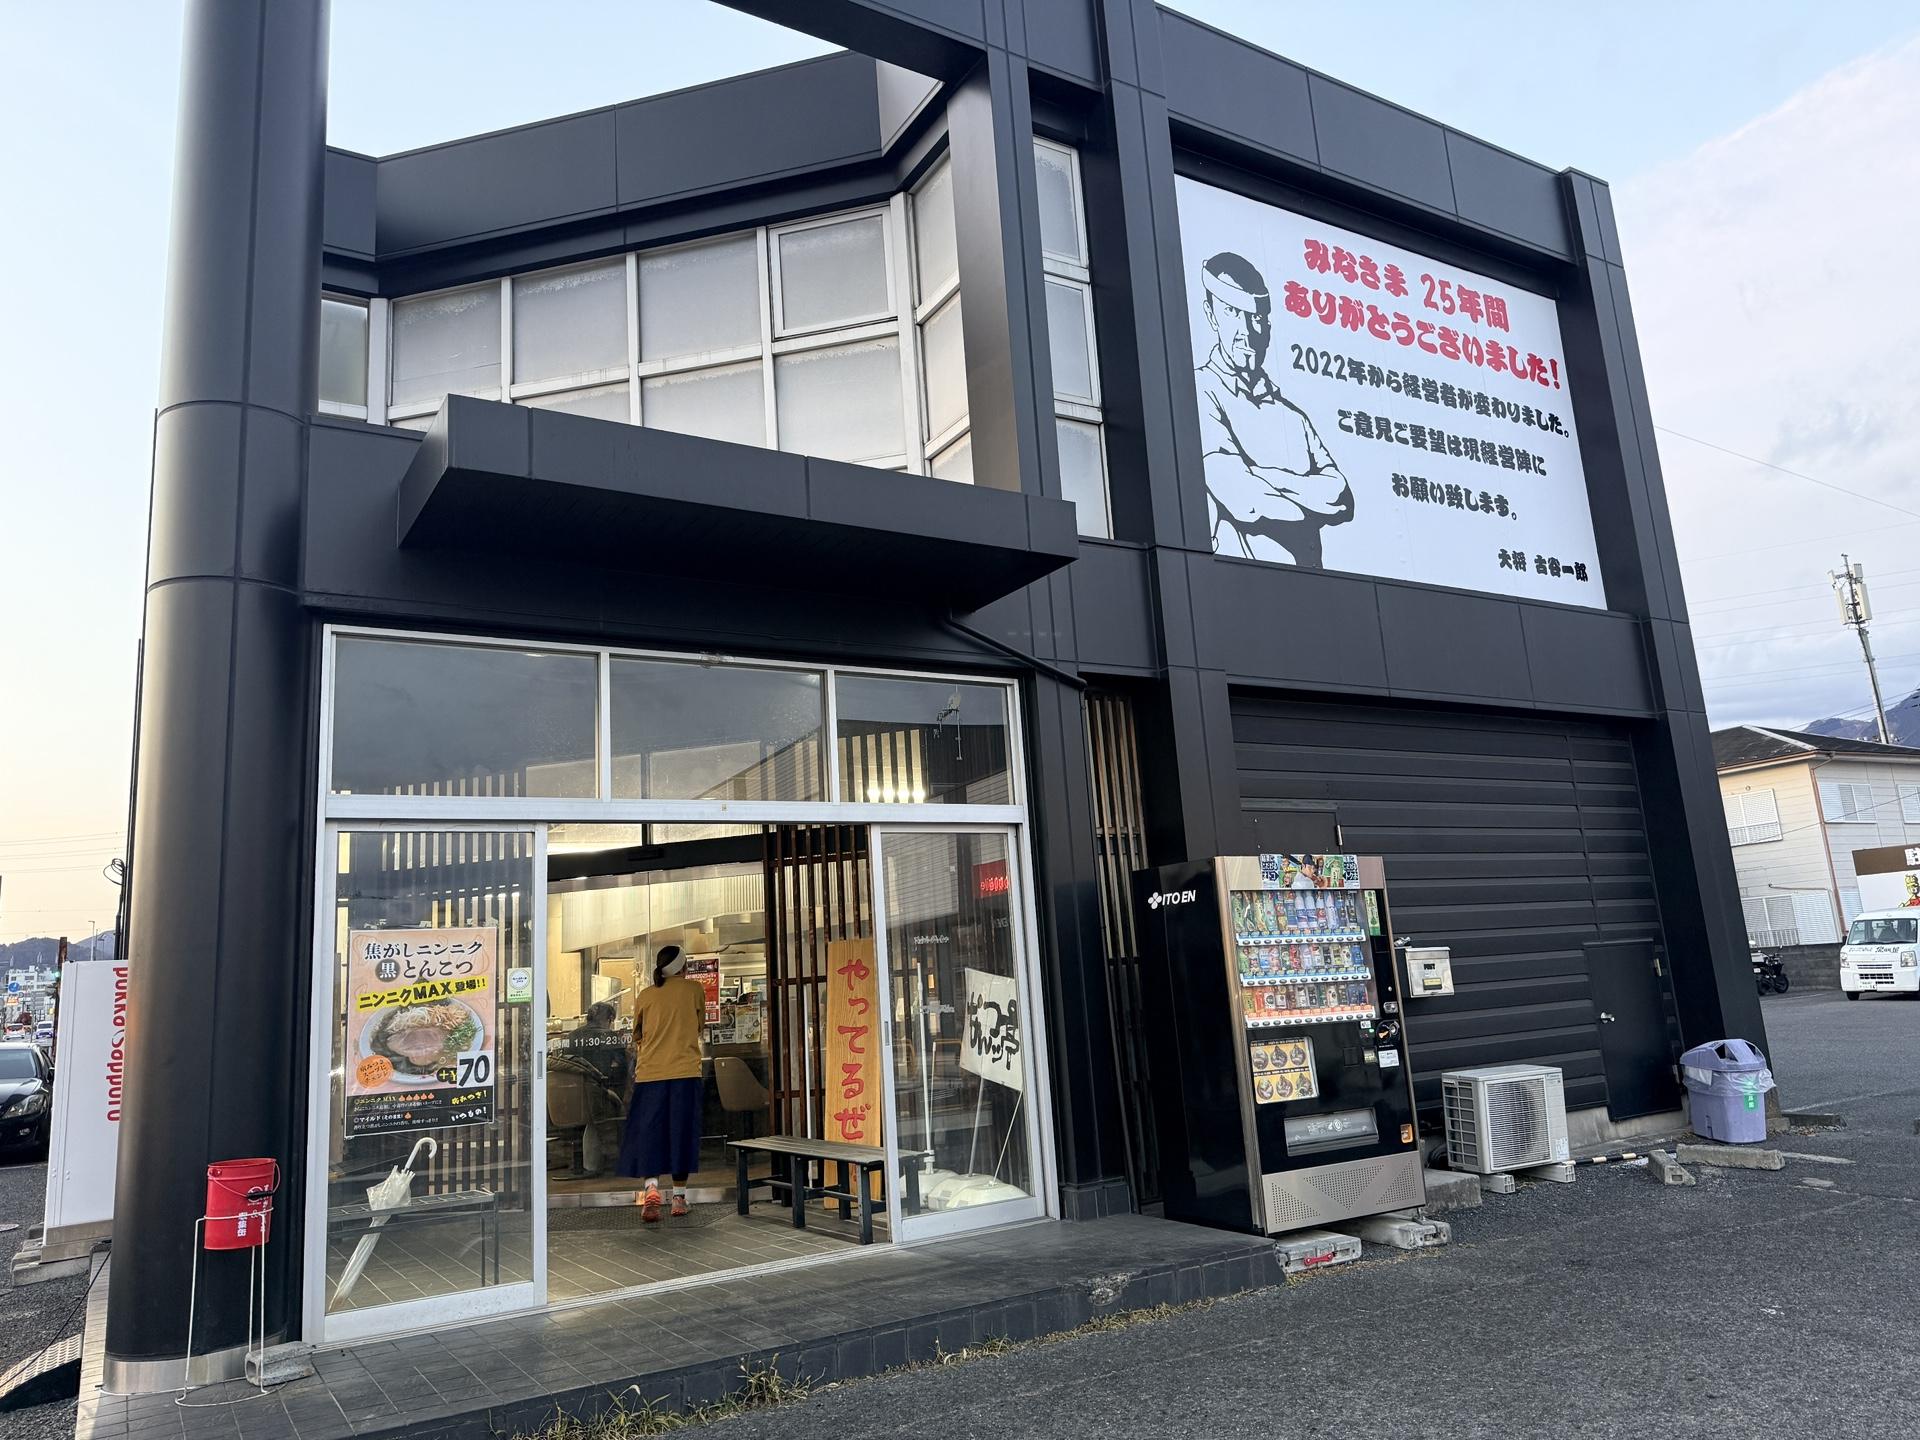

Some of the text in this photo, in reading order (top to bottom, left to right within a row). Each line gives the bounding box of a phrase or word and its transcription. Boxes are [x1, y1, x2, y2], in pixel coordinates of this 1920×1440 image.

[1303, 238, 1510, 332] みなさま 25年間
[1283, 280, 1561, 390] ありがとうございました!
[1290, 343, 1570, 438] 2022年から経営者が変わりました。
[1337, 408, 1547, 476] ご意見ご要望は現経営陣に
[1391, 472, 1517, 521] お願い致します。
[1498, 548, 1590, 583] 大将 古谷一郎
[1162, 889, 1196, 906] ITO EN
[364, 941, 483, 960] 焦がしニンニク
[379, 959, 473, 979] 黒 とんこつ
[359, 982, 453, 1008] ニンニクMAX
[458, 1054, 490, 1087] 70
[833, 958, 872, 1141] やってるぜ
